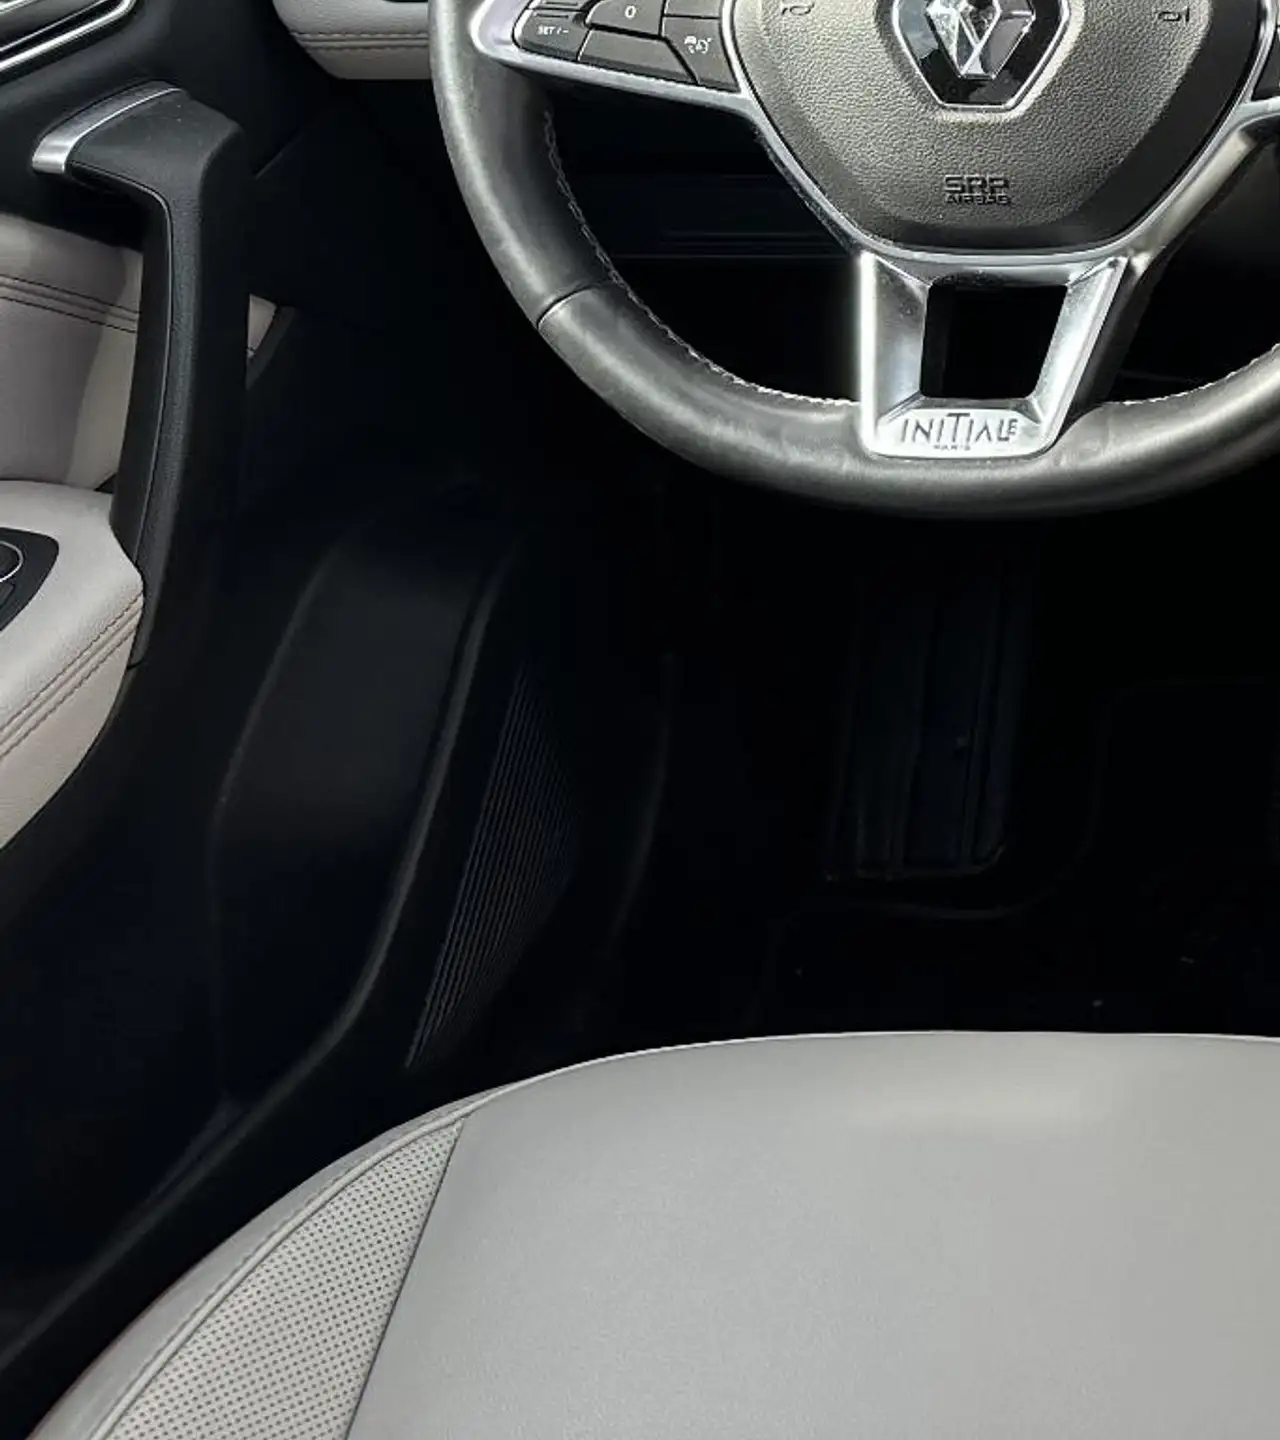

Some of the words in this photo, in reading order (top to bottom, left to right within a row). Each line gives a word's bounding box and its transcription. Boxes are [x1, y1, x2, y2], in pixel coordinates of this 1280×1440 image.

[624, 5, 636, 19] 0
[943, 174, 1010, 194] SRP
[901, 412, 1018, 443] INITIALE
